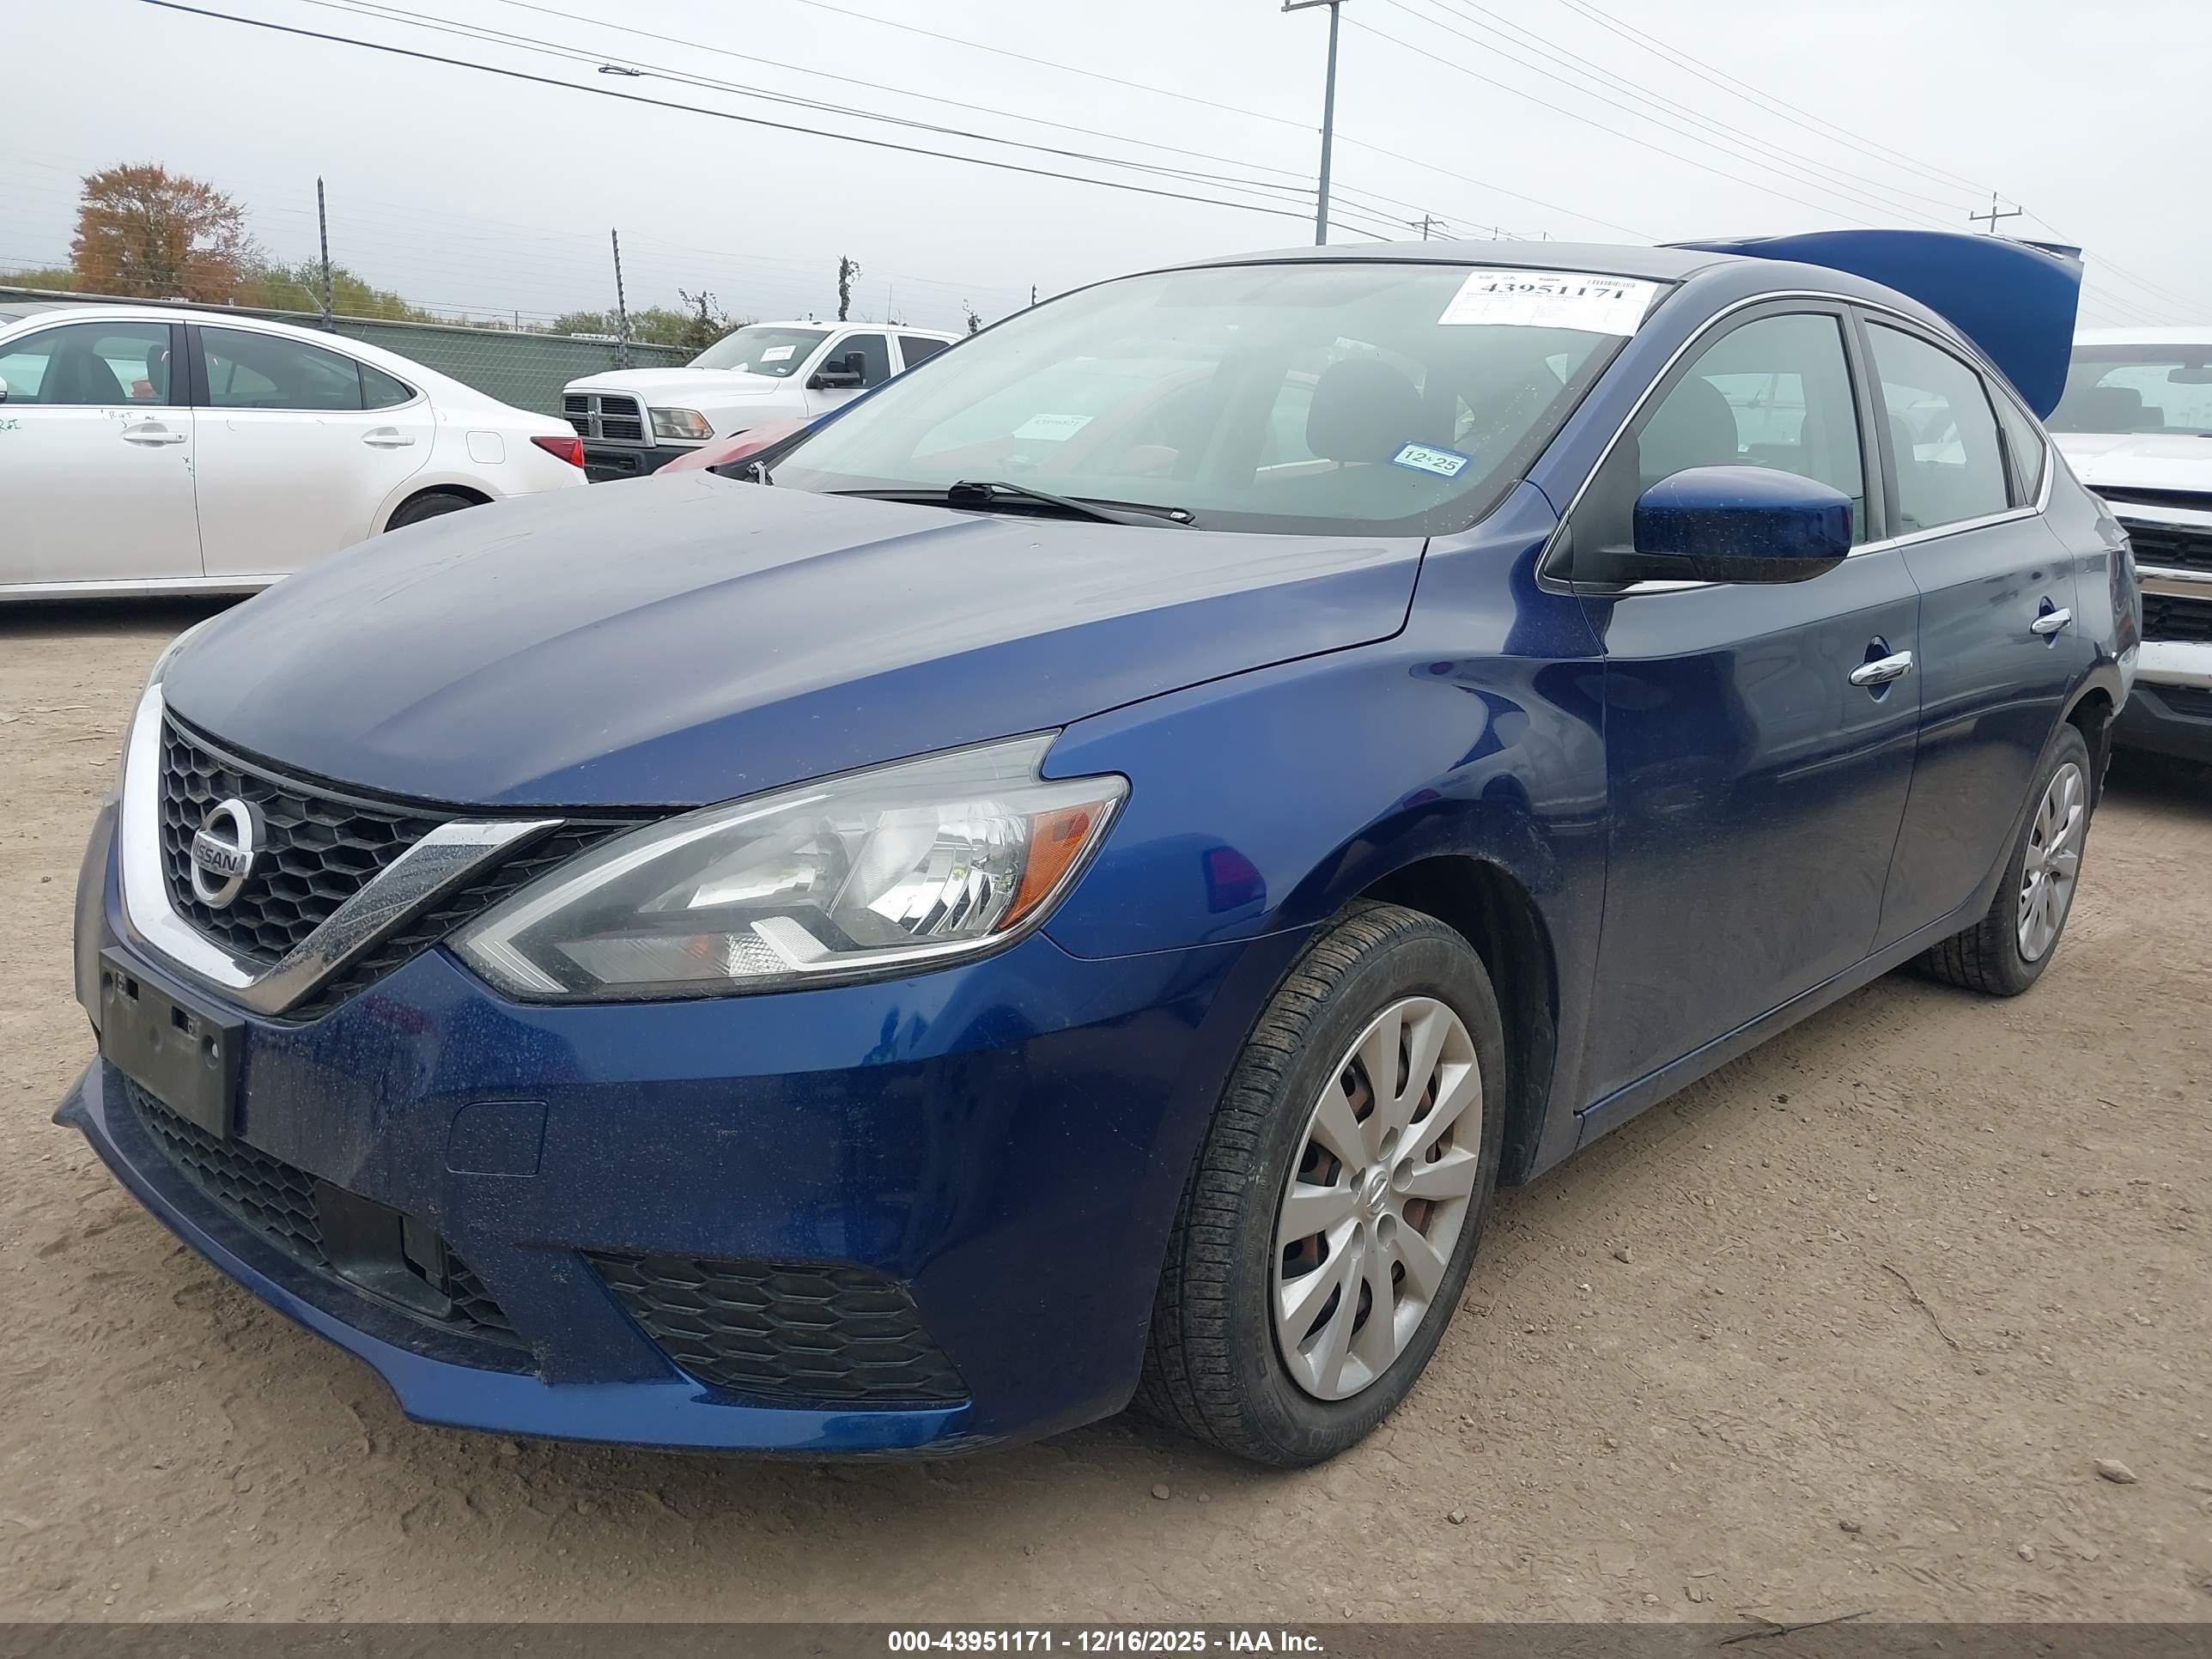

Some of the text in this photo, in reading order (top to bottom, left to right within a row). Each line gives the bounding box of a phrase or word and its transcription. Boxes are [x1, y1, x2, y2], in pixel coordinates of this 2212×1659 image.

[1480, 283, 1625, 299] 43951171
[1405, 450, 1459, 471] 12 25
[192, 839, 237, 871] NISSAN
